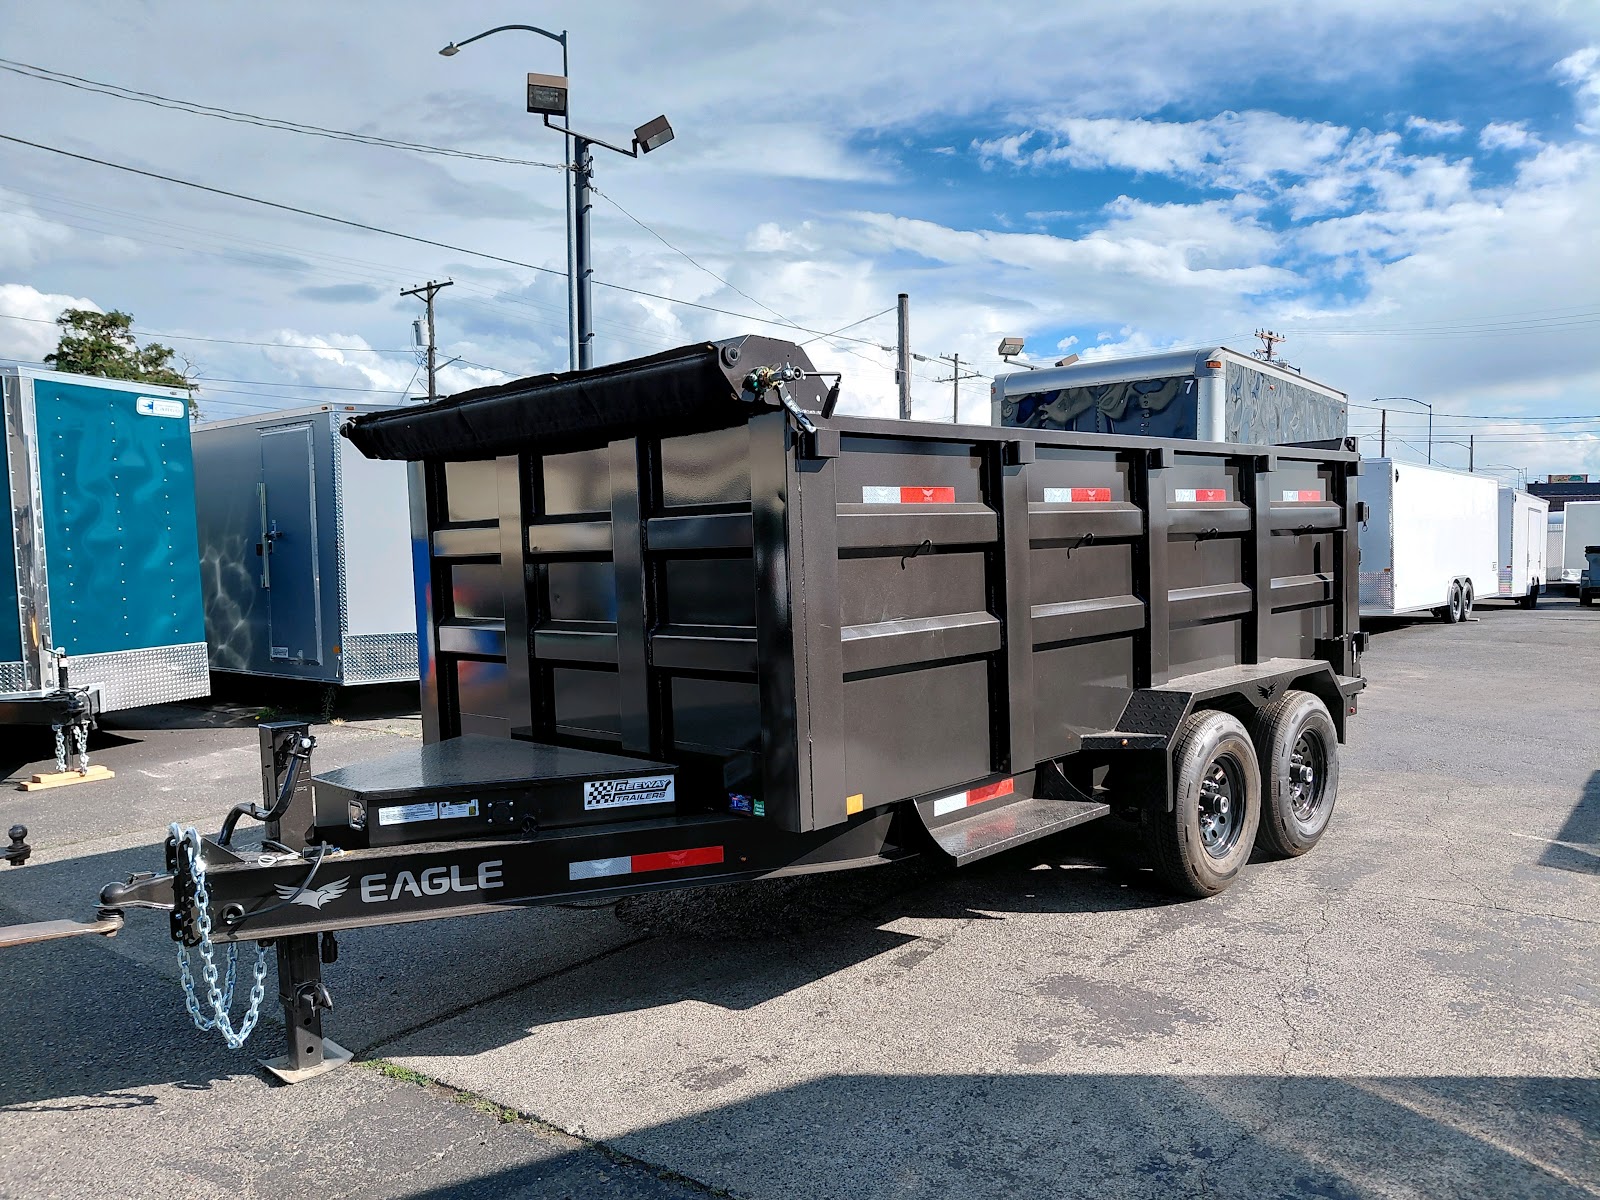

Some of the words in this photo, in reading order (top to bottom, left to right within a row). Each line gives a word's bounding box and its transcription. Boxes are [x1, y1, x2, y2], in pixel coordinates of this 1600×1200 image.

[1185, 380, 1194, 394] 7
[605, 780, 672, 801] FREEWAY
[616, 792, 666, 802] TRAILERS
[361, 860, 504, 903] EAGLE
